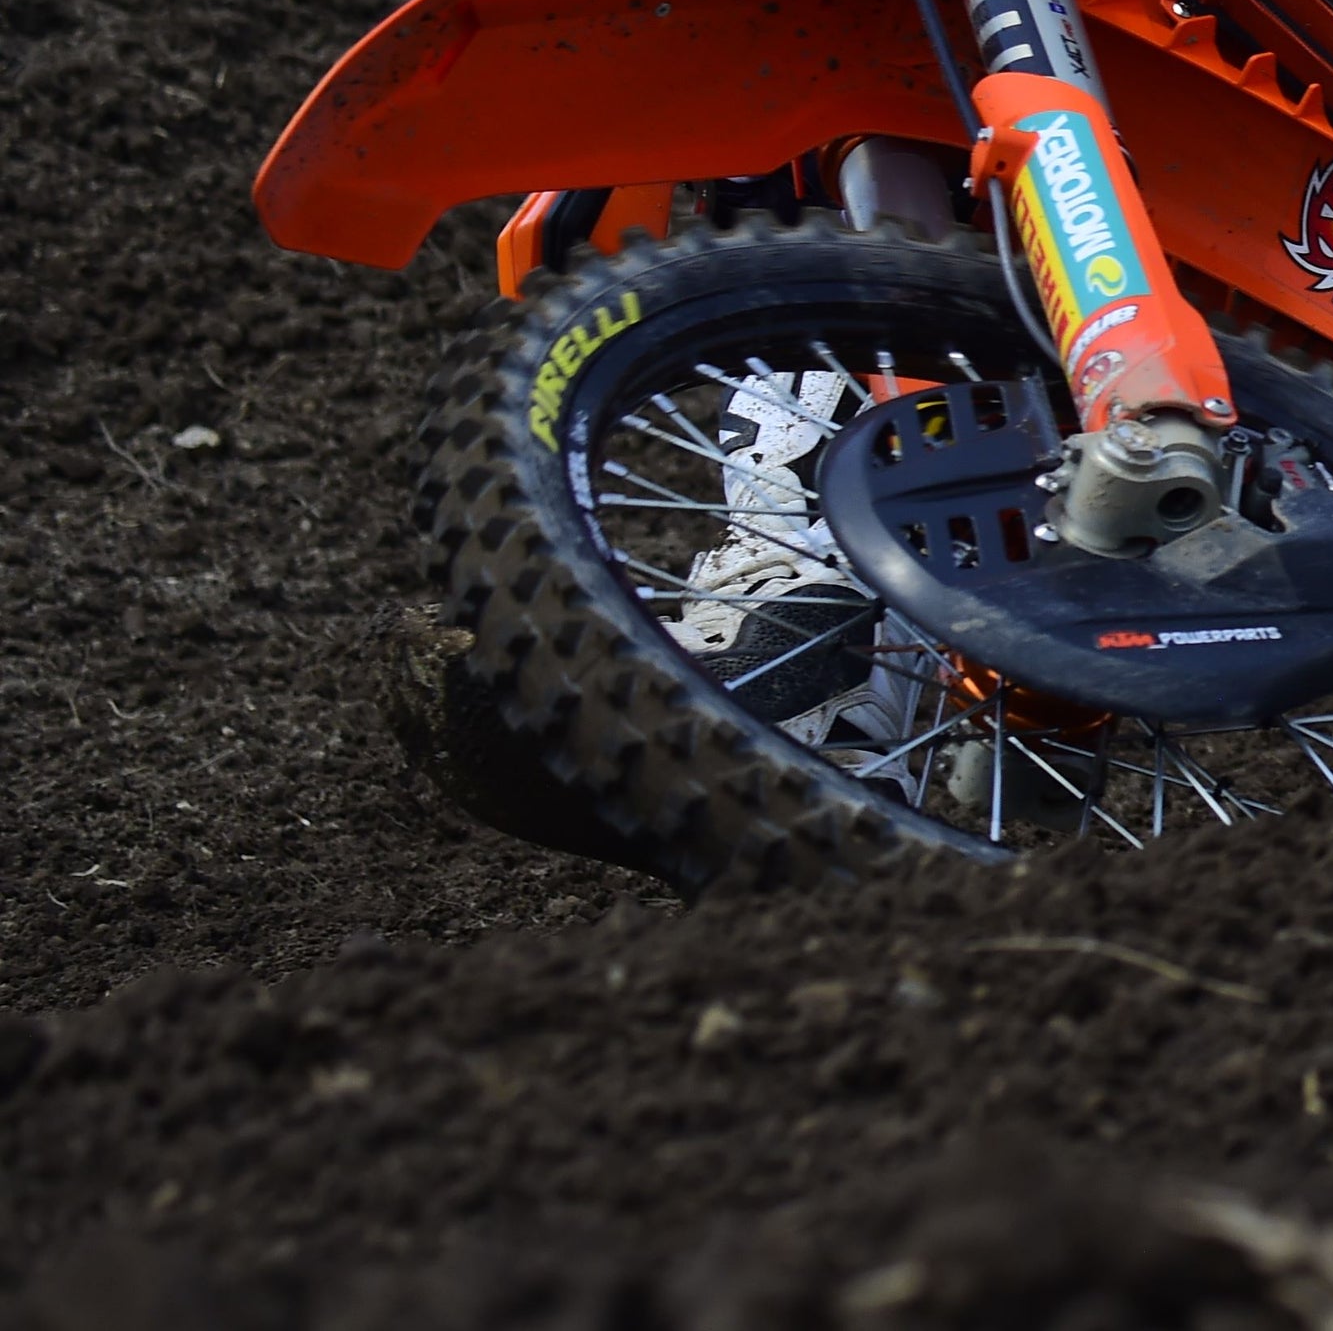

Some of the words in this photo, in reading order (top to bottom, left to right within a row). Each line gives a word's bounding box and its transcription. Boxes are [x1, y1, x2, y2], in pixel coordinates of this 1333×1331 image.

[1060, 34, 1091, 79] XACT
[1034, 113, 1117, 263] MOTOREX
[529, 291, 642, 454] PIRELLI
